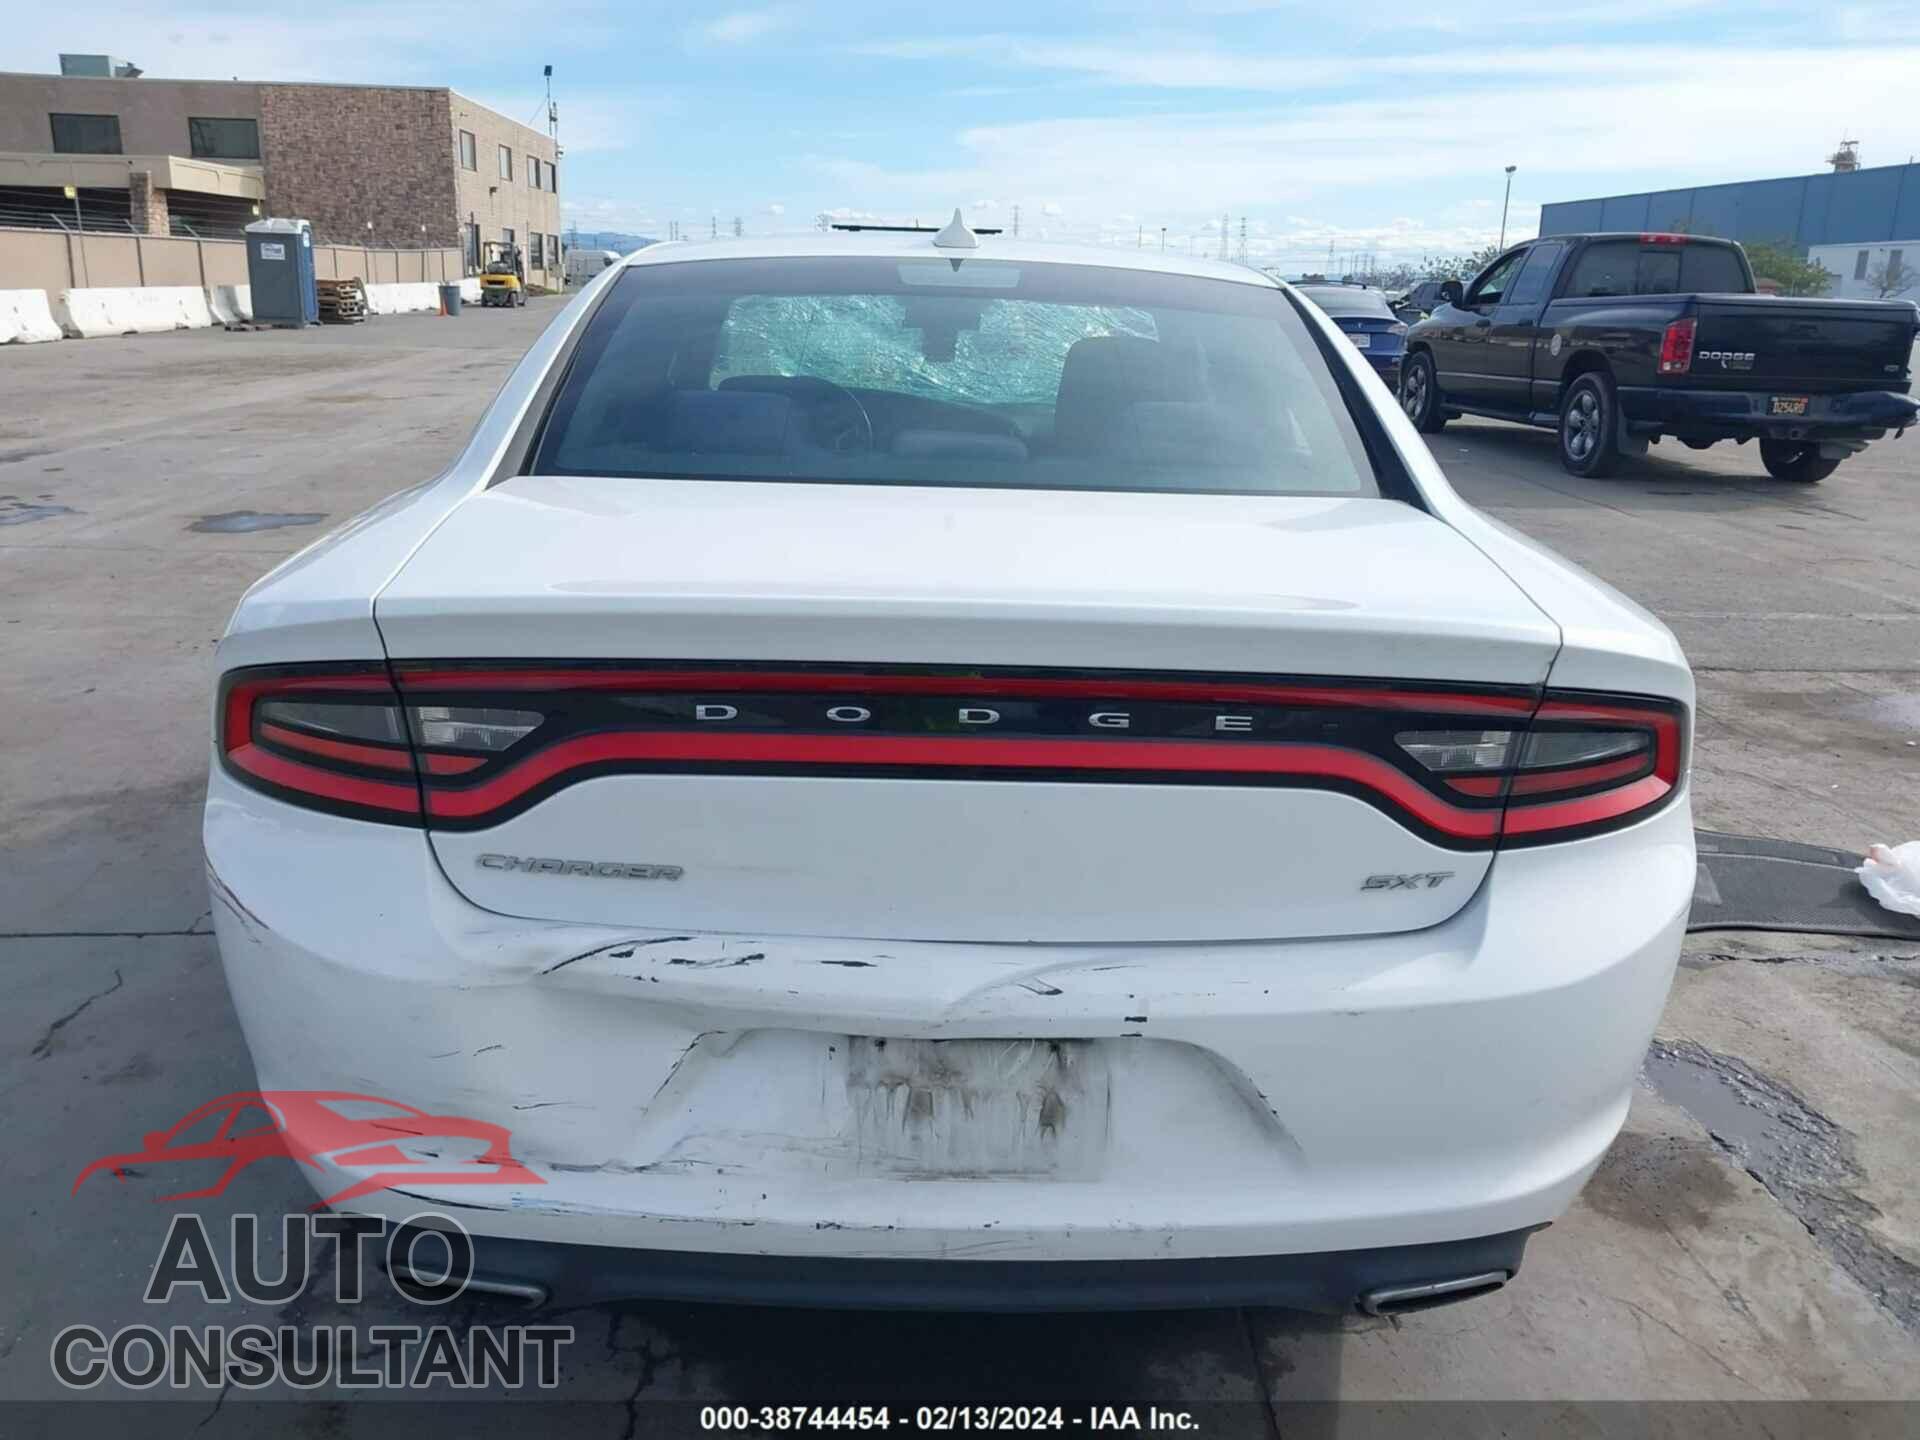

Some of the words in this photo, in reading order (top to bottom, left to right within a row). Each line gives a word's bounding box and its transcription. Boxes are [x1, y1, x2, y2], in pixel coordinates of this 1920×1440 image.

[1699, 351, 1756, 361] DODGE
[695, 704, 1254, 732] DODGE
[475, 853, 685, 881] CHARGER
[1361, 871, 1456, 890] SXT
